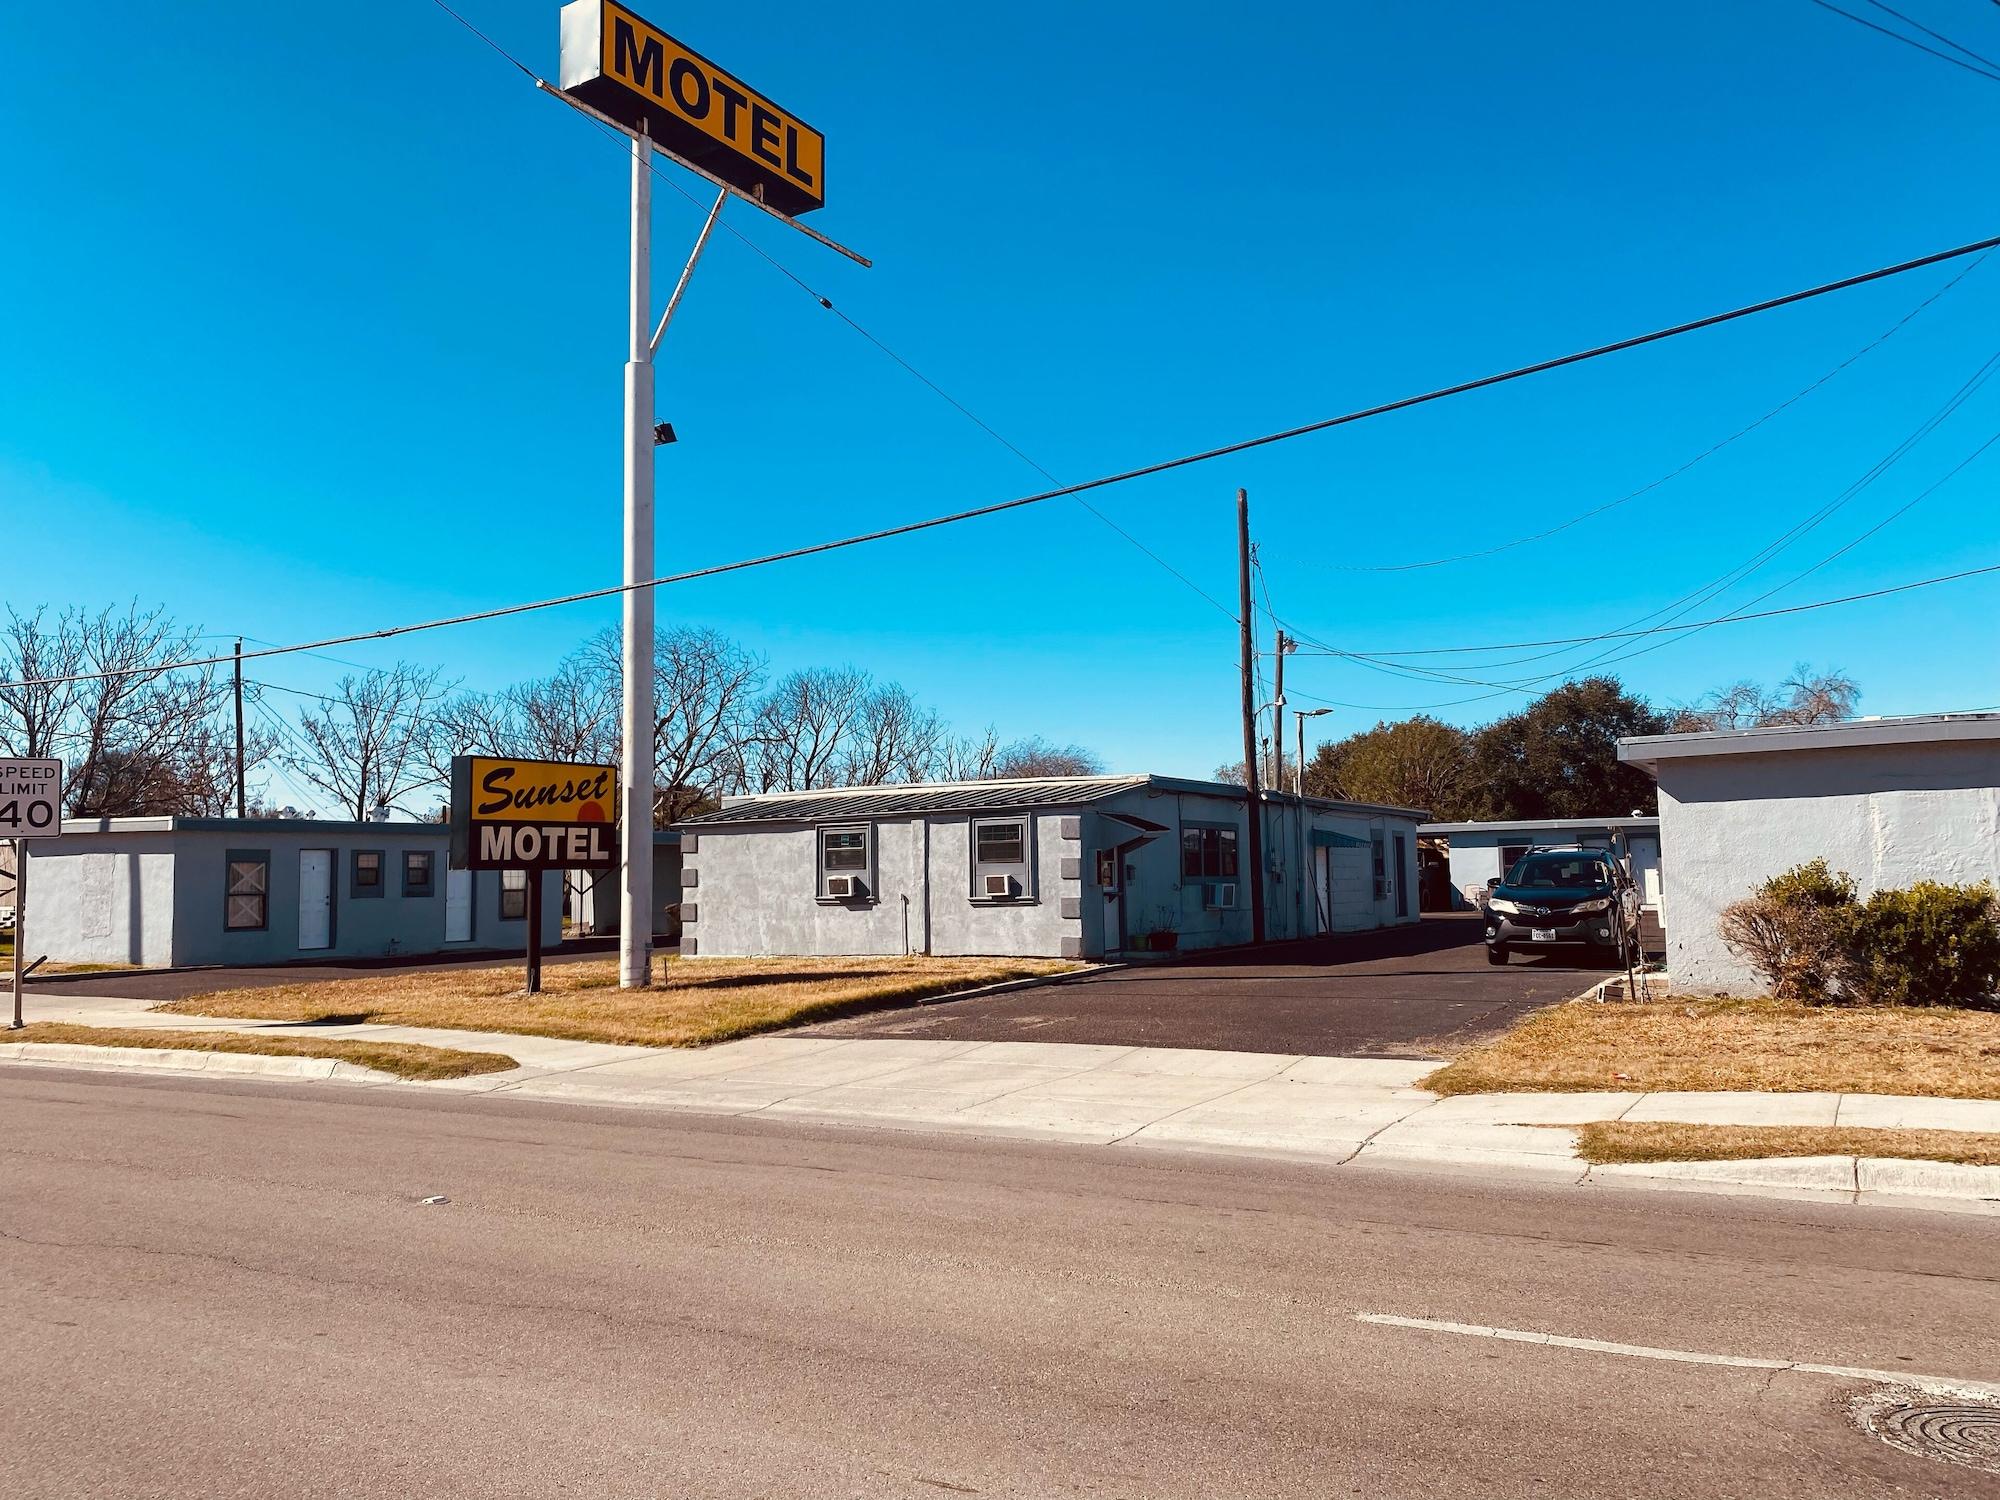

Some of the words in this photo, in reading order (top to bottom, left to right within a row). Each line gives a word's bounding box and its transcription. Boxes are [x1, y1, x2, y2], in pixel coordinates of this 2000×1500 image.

[614, 15, 813, 188] MOTEL
[0, 783, 48, 795] LIMIT
[478, 767, 609, 815] Sunset
[0, 800, 53, 829] 40
[480, 825, 609, 861] MOTEL
